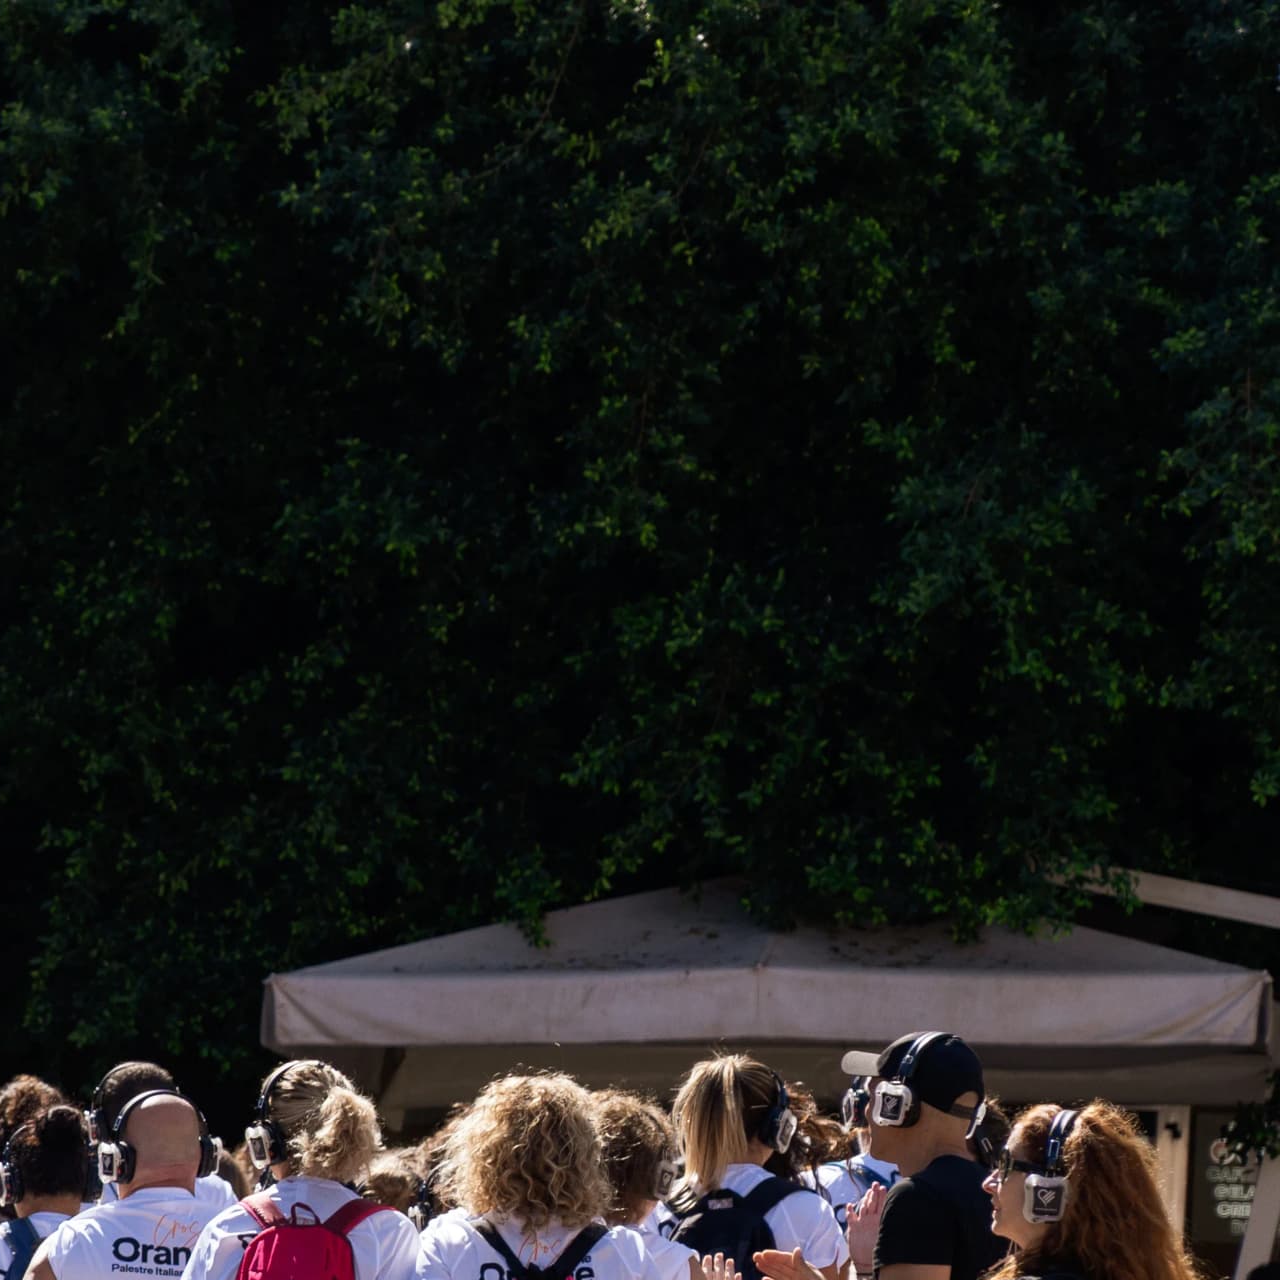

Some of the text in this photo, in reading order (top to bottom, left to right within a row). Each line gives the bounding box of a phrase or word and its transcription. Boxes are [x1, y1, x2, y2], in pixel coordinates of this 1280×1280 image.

[111, 1237, 191, 1266] Oran
[111, 1263, 185, 1278] Palestre Italia
